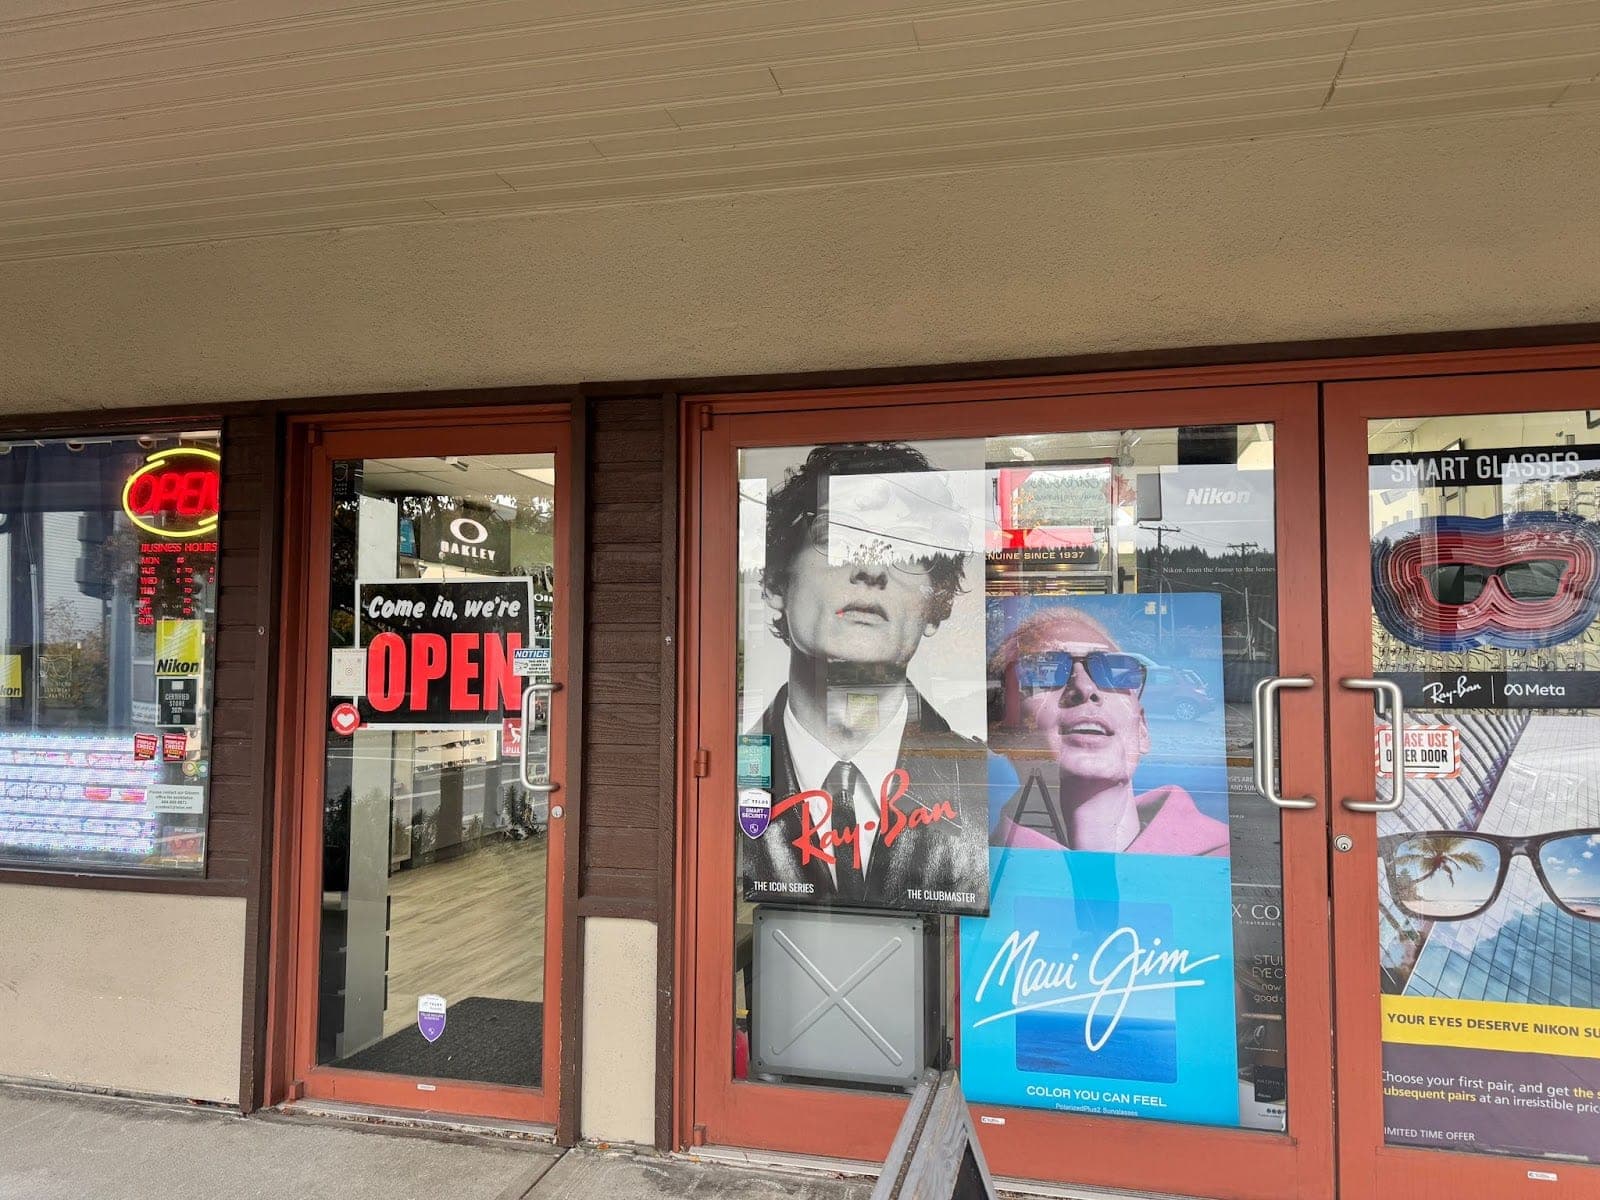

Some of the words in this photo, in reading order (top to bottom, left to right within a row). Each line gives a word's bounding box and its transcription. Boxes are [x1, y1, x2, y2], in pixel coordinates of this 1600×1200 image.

[1390, 456, 1469, 483] SMART
[1476, 451, 1580, 480] GLASSES
[130, 472, 219, 515] OPEN
[1185, 488, 1250, 505] Nikon
[141, 543, 181, 552] BUSINESS
[185, 543, 217, 552] HOURS
[440, 541, 496, 561] OAKLEY
[986, 552, 1020, 560] NUINE
[1024, 552, 1056, 560] SINCE
[1060, 551, 1085, 559] 1937
[368, 595, 426, 618] Come
[432, 595, 458, 621] in,
[464, 596, 521, 618] we're
[138, 617, 154, 625] SUN
[515, 650, 549, 658] NOTICE
[156, 659, 199, 673] Nikon
[367, 632, 522, 712] OPEN
[0, 685, 20, 696] kon
[1422, 675, 1482, 704] Ray-Ban
[1526, 683, 1565, 697] Meta
[1385, 733, 1424, 748] PASE
[1427, 733, 1448, 747] USE
[1386, 749, 1417, 762] OER
[1421, 749, 1448, 762] DOOR
[770, 769, 958, 870] Ray-Ban
[754, 881, 767, 892] THE
[769, 882, 787, 892] ICON
[789, 883, 814, 893] SERIES
[907, 889, 922, 900] THE
[923, 890, 976, 903] CLUBMASTER
[975, 930, 1079, 1006] Maui
[1085, 927, 1221, 1052] Jim
[1262, 983, 1281, 991] now
[1254, 994, 1279, 1003] good
[1387, 1013, 1425, 1026] YOUR
[1429, 1016, 1463, 1028] EYES
[1467, 1018, 1529, 1033] DESERVE
[1533, 1024, 1579, 1038] NIKON
[1427, 1076, 1455, 1088] your
[1458, 1076, 1484, 1089] first
[1488, 1080, 1514, 1093] pair,
[1519, 1082, 1543, 1093] and
[1547, 1086, 1570, 1098] get
[1573, 1087, 1594, 1099] the
[1026, 1085, 1071, 1099] COLOR
[1074, 1089, 1099, 1101] YOU
[1102, 1092, 1130, 1104] CAN
[1133, 1095, 1167, 1107] FEEL
[1384, 1086, 1446, 1100] ubsequent
[1448, 1091, 1477, 1103] pairs
[1479, 1094, 1492, 1103] at
[1494, 1097, 1510, 1105] an
[1513, 1096, 1574, 1111] irresistible
[1577, 1102, 1600, 1114] pric
[1102, 1106, 1138, 1117] Sunglasses
[1383, 1126, 1418, 1138] IMITED
[1420, 1129, 1444, 1139] TIME
[1446, 1131, 1476, 1142] OFFER
